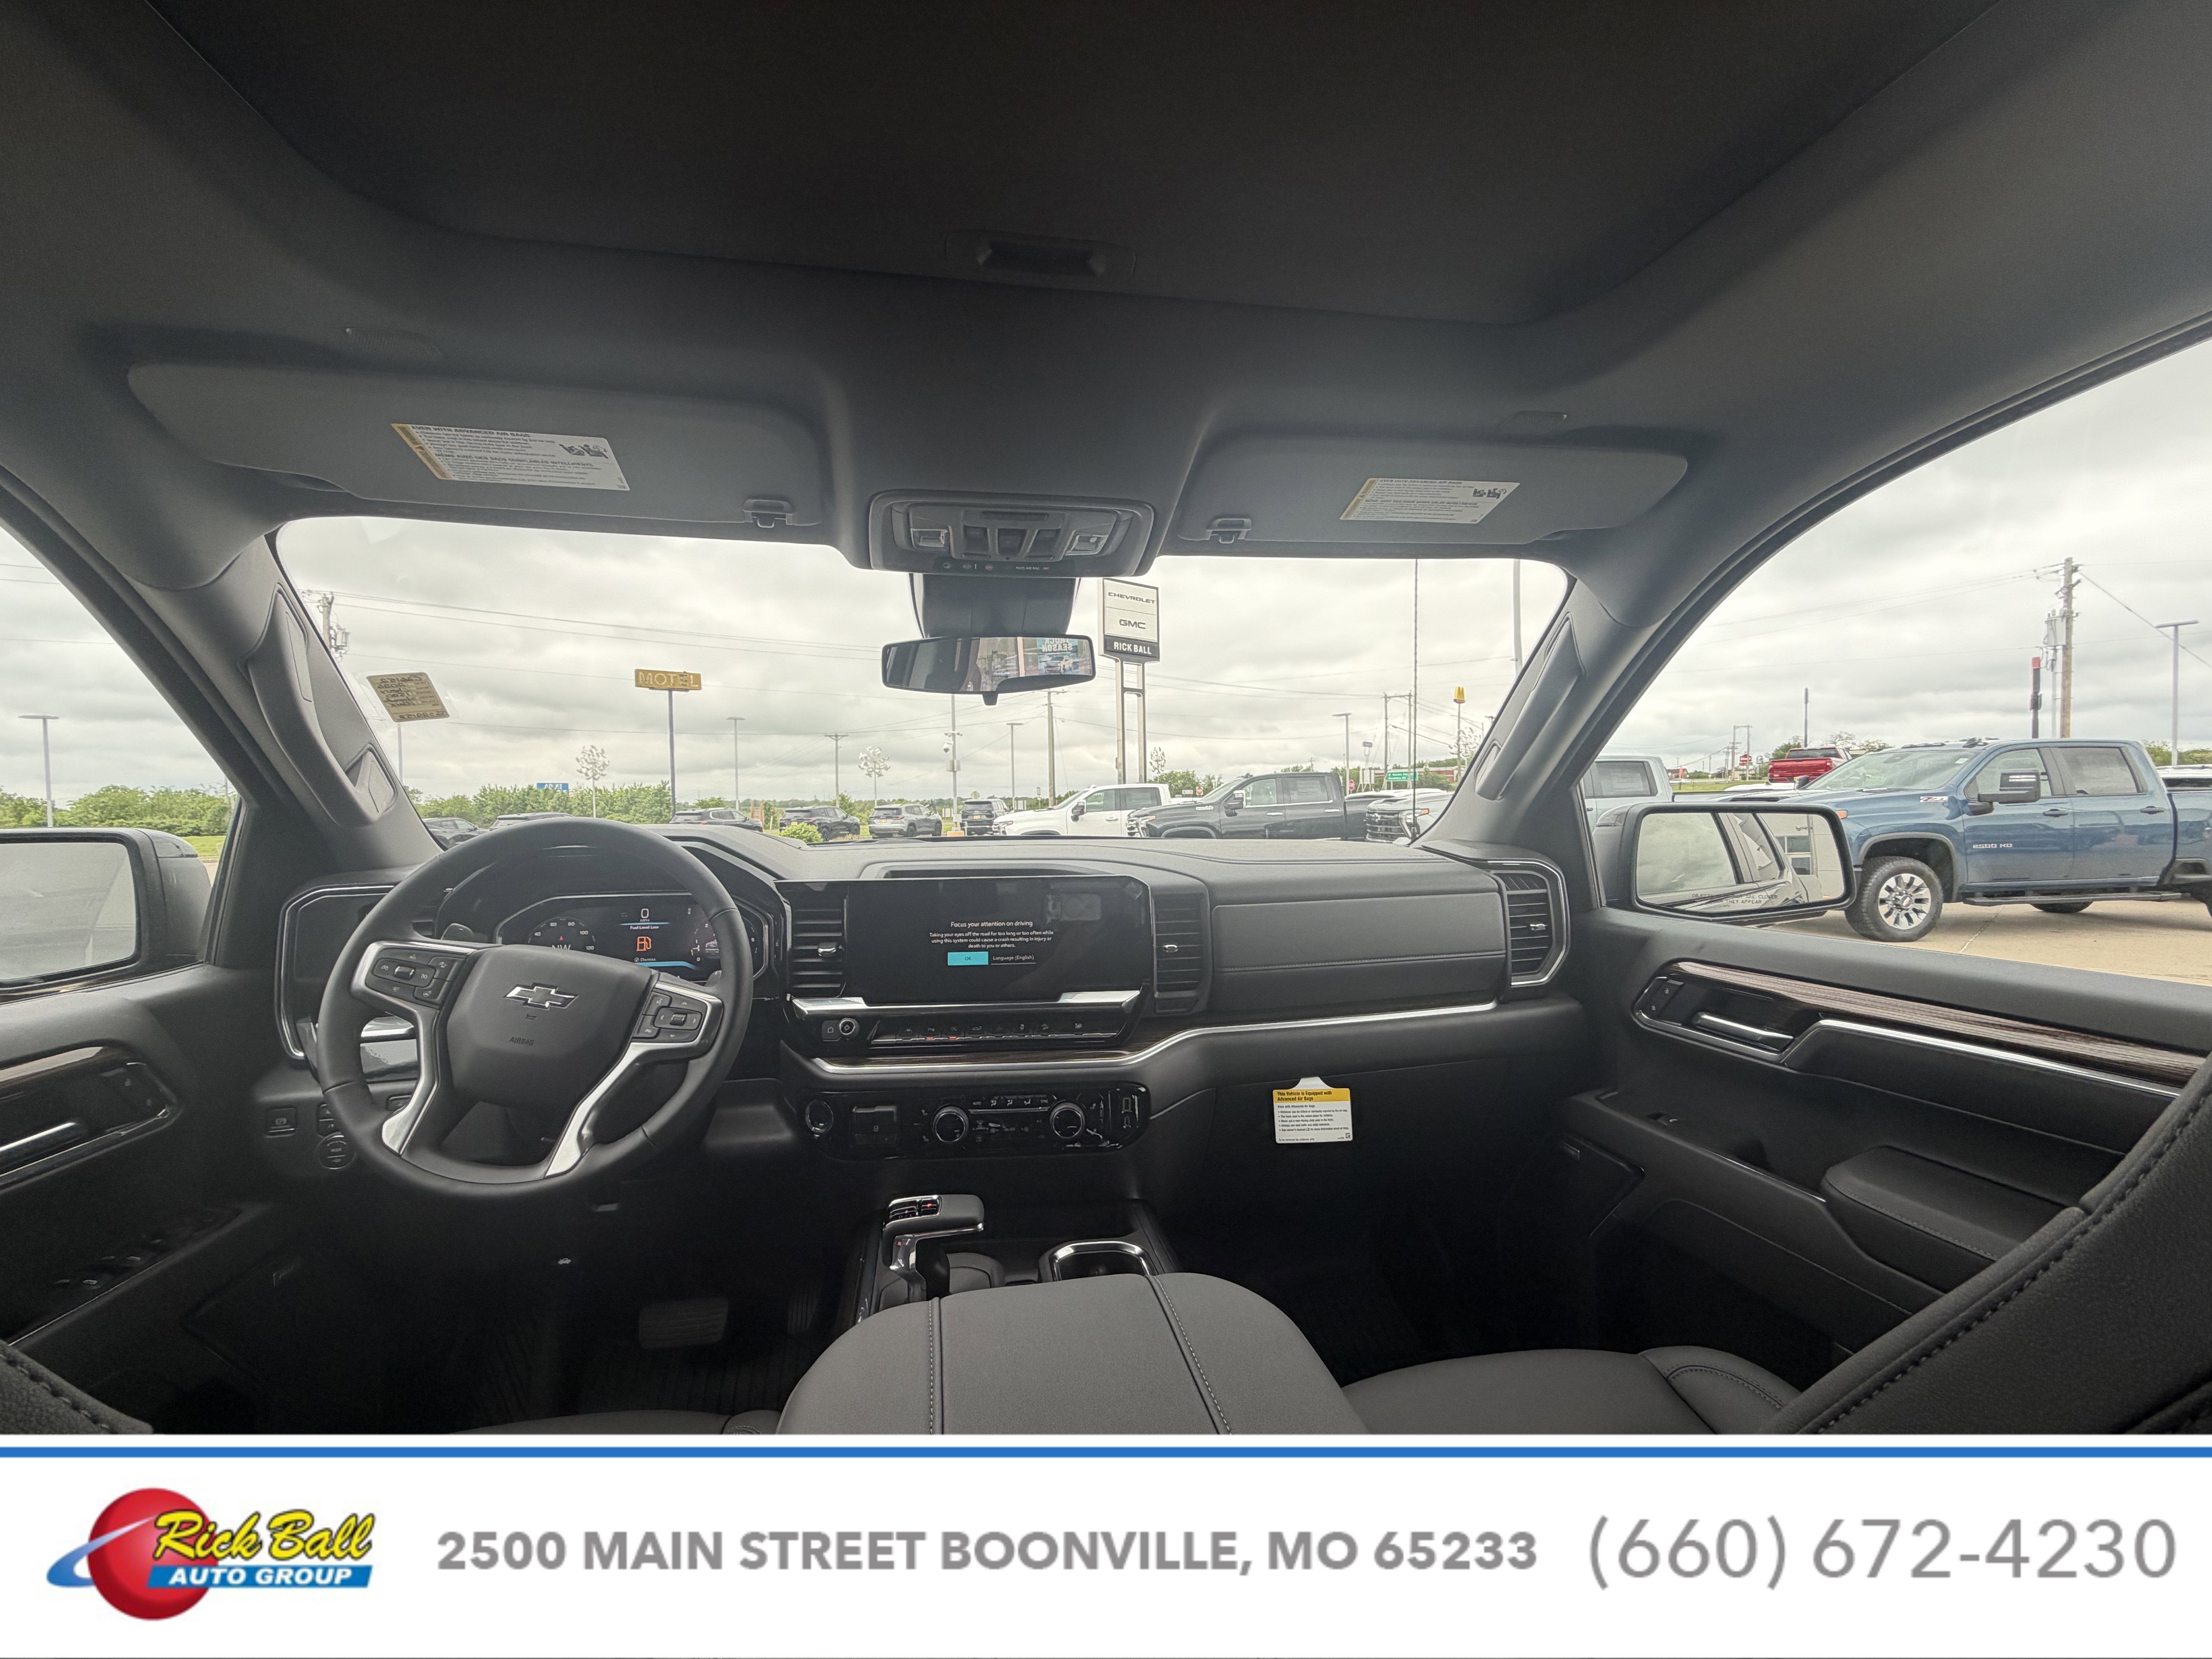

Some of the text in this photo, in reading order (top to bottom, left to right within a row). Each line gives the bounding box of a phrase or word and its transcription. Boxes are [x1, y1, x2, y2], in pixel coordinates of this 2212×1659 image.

[1108, 592, 1156, 604] CHEVROLET
[1119, 619, 1146, 629] GMC
[1114, 641, 1152, 654] RICK BALL
[639, 672, 699, 687] MOTEL
